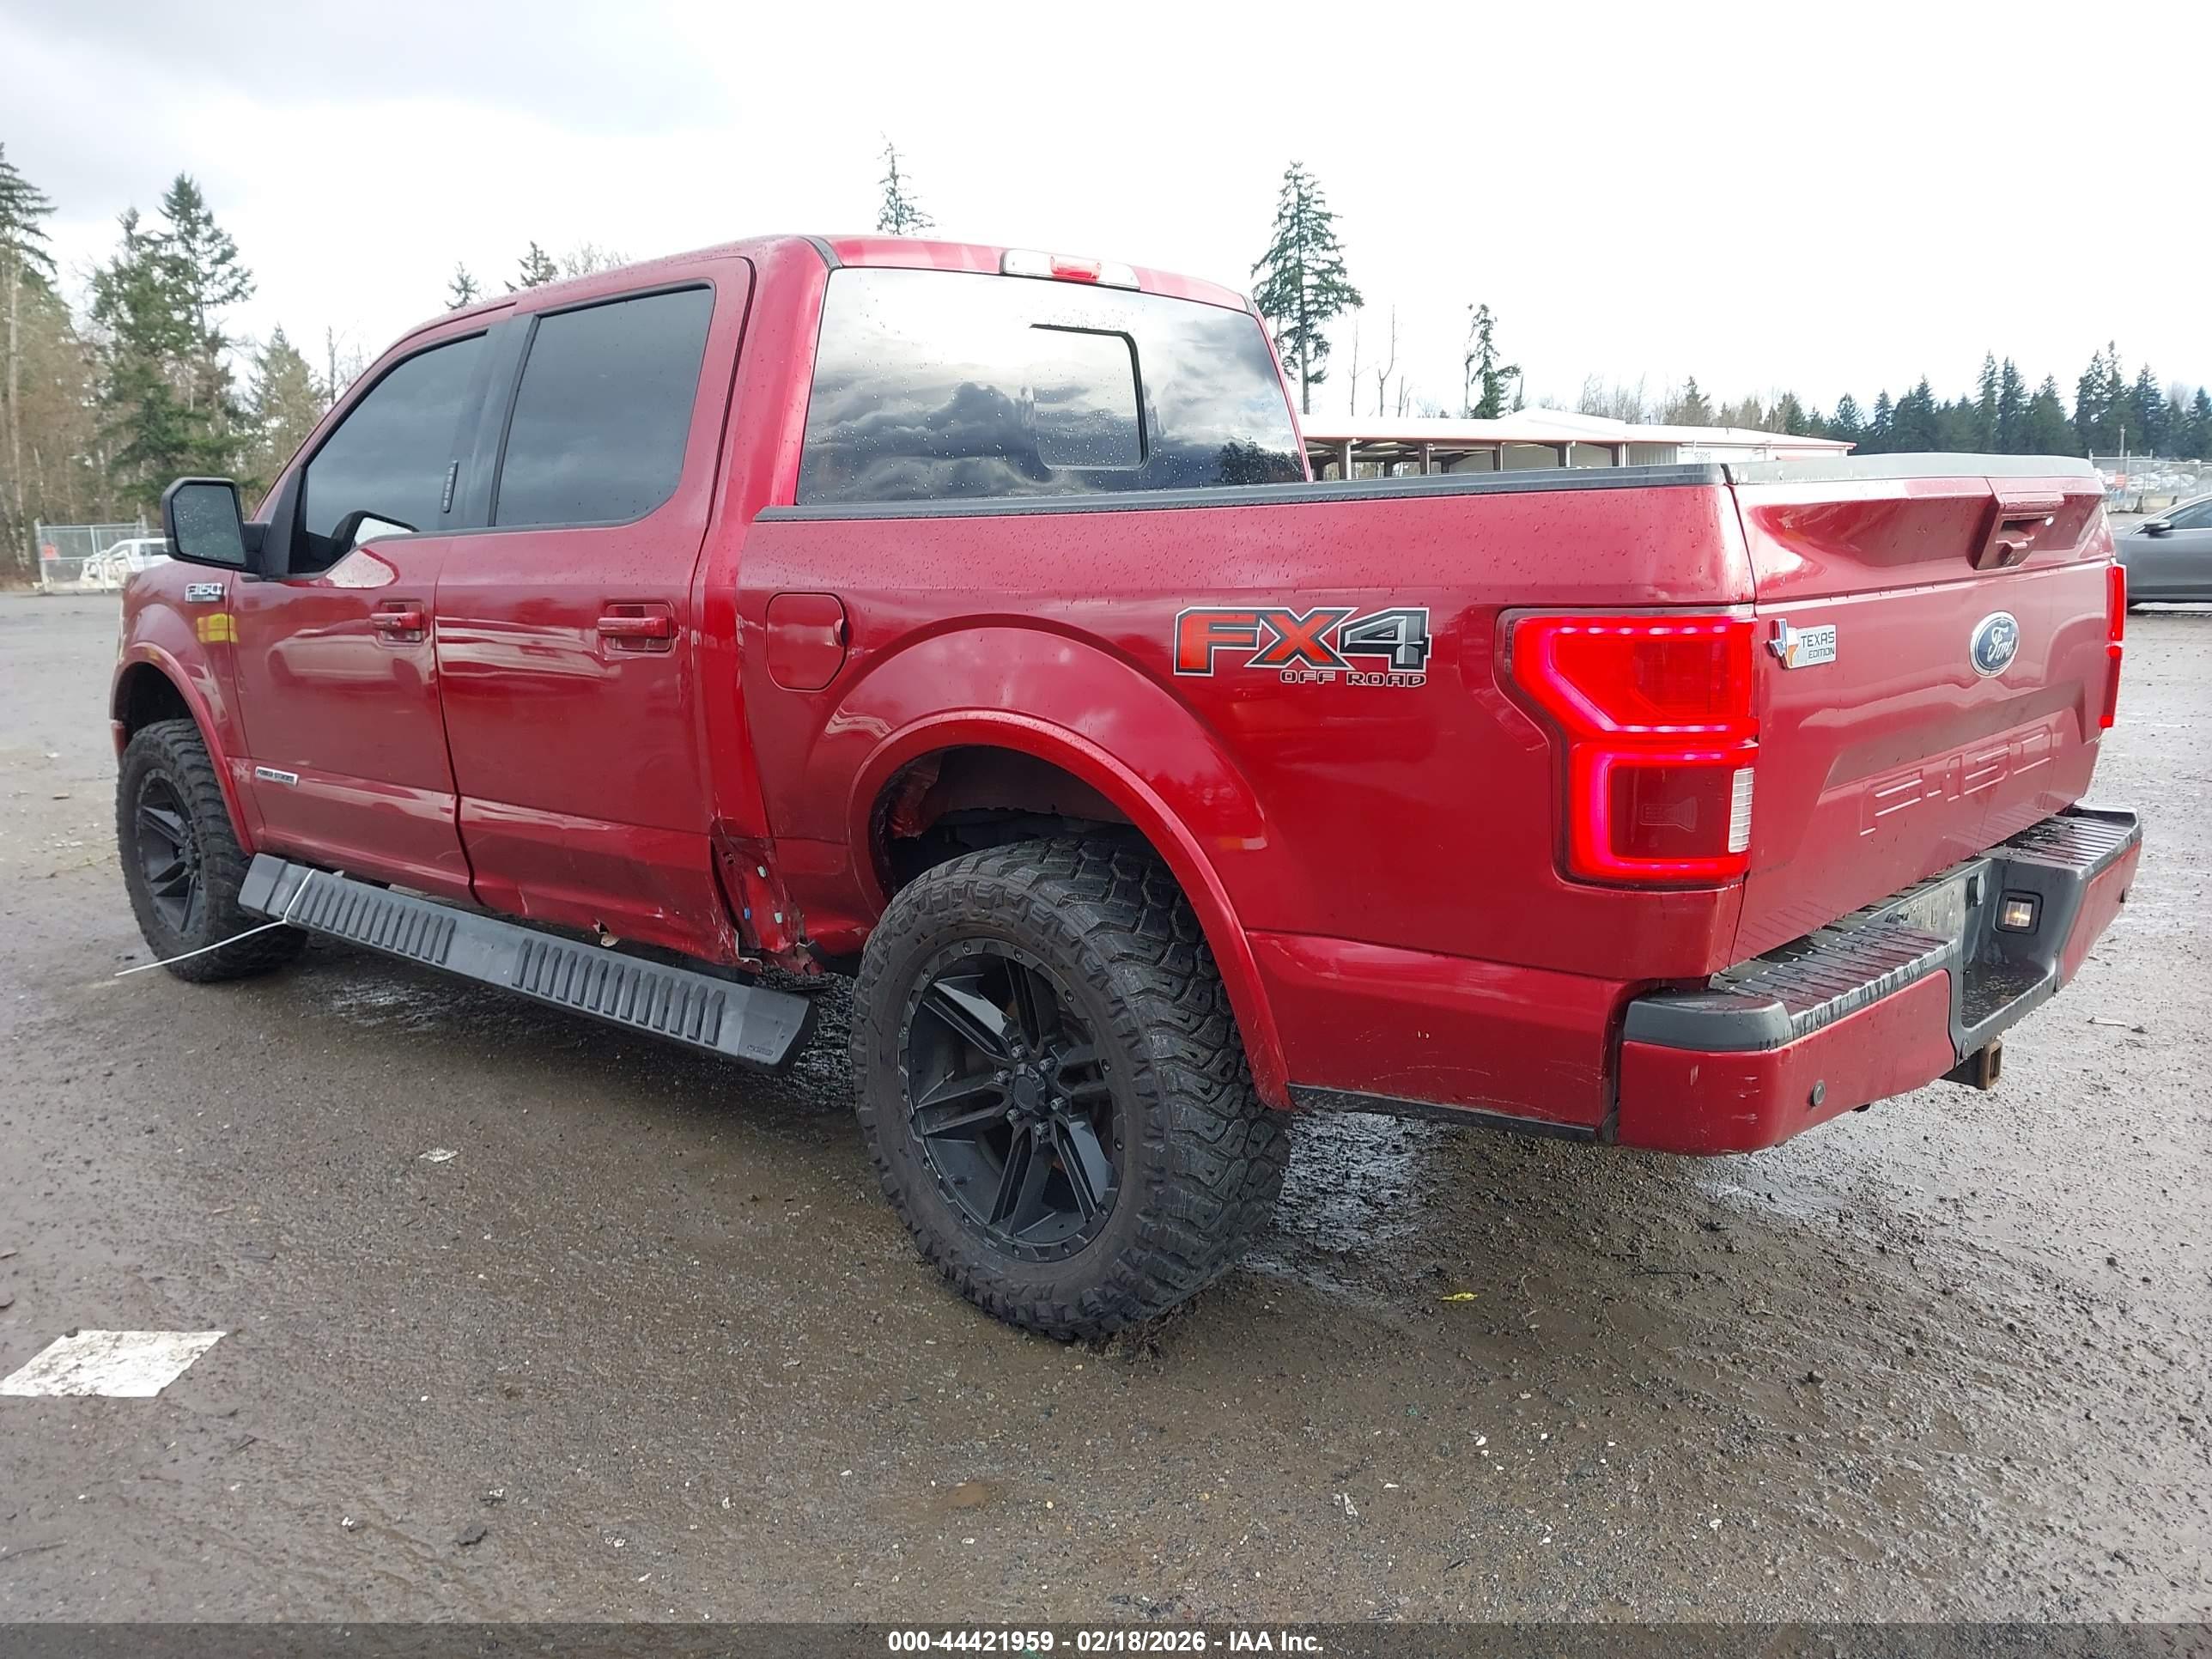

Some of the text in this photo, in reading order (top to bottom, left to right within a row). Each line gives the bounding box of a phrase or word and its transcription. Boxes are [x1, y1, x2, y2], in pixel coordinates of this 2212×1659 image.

[1174, 606, 1432, 677] FX4
[1800, 631, 1835, 648] TEXAS
[1808, 647, 1835, 659] EDITION
[1986, 626, 2015, 663] Ford
[1279, 669, 1426, 688] OFF ROAD
[1860, 724, 2053, 836] F-150
